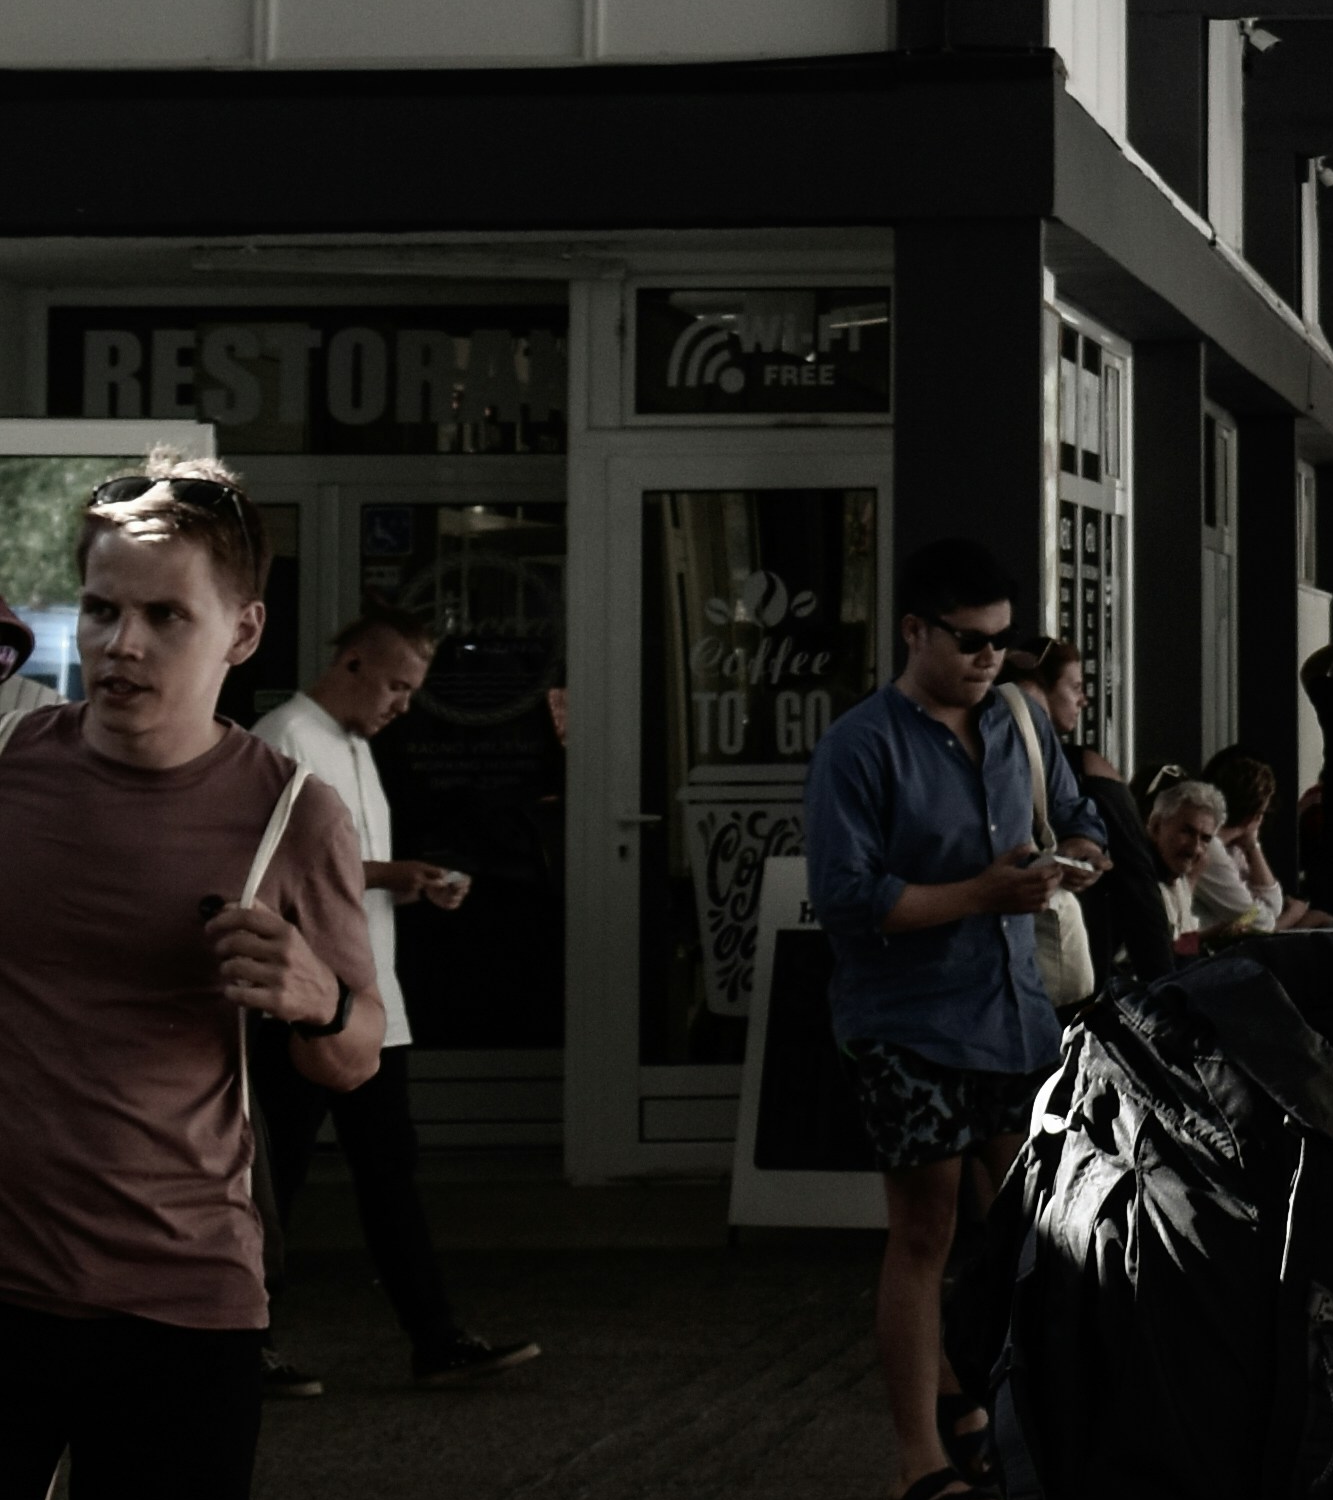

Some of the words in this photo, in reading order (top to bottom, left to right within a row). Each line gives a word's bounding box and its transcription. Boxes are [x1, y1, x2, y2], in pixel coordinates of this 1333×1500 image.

[762, 363, 836, 387] FREE
[690, 636, 833, 686] Coffee
[692, 689, 747, 756] TO
[774, 688, 833, 756] GO
